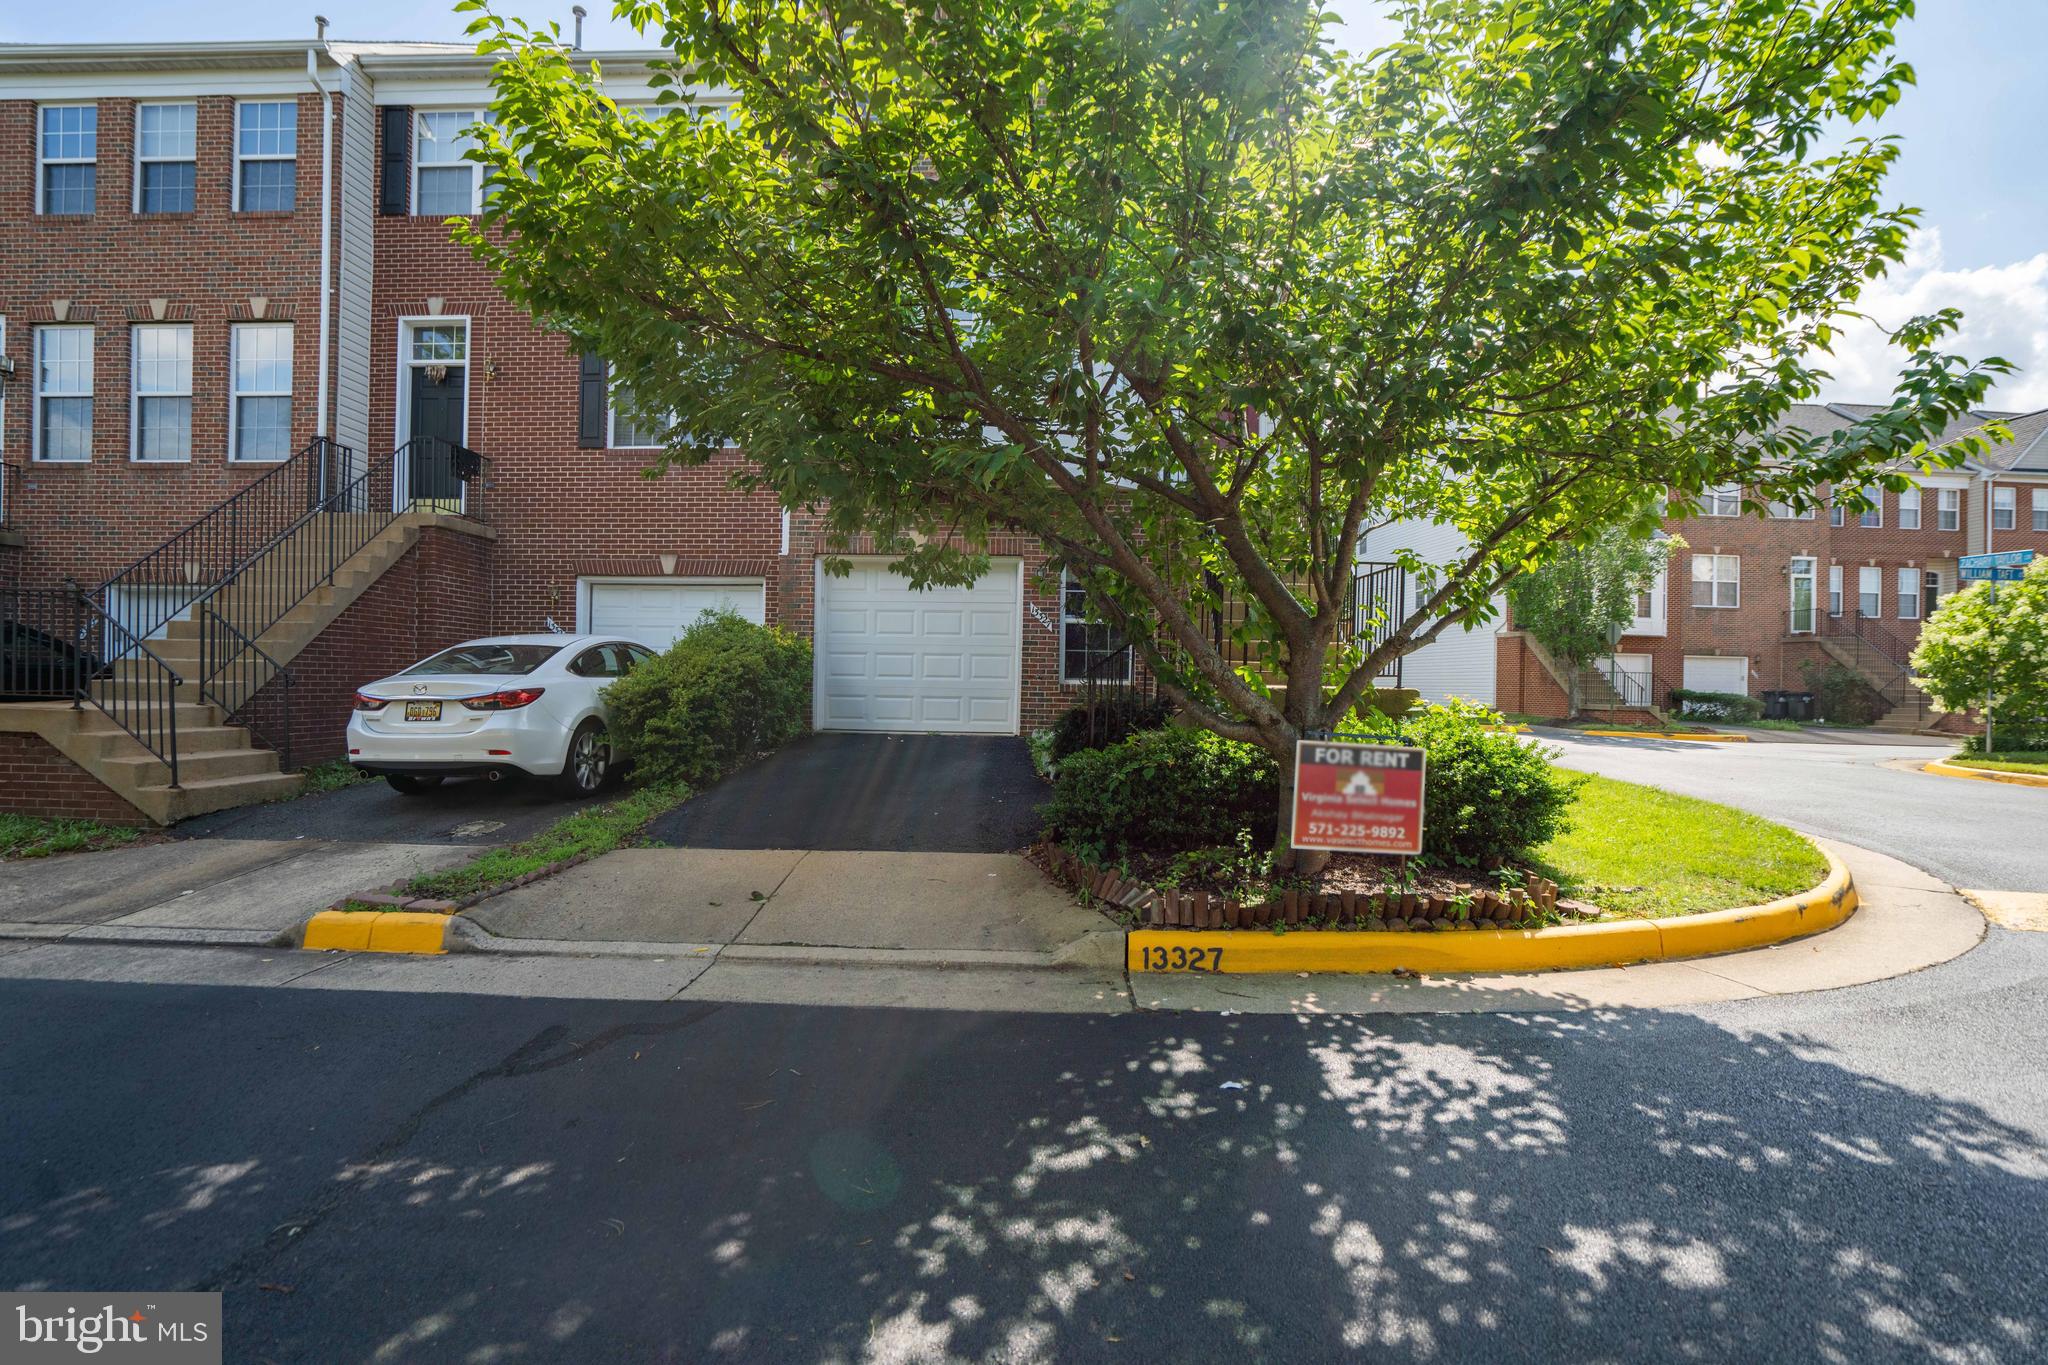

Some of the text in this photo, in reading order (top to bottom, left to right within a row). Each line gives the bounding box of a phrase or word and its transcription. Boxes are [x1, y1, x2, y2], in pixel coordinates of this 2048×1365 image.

[1960, 568, 1992, 579] WILLIAM
[1314, 747, 1410, 768] FOR RENT
[1301, 791, 1343, 805] Virginia
[1308, 822, 1406, 839] 571-225-9892
[1142, 946, 1224, 971] 13327
